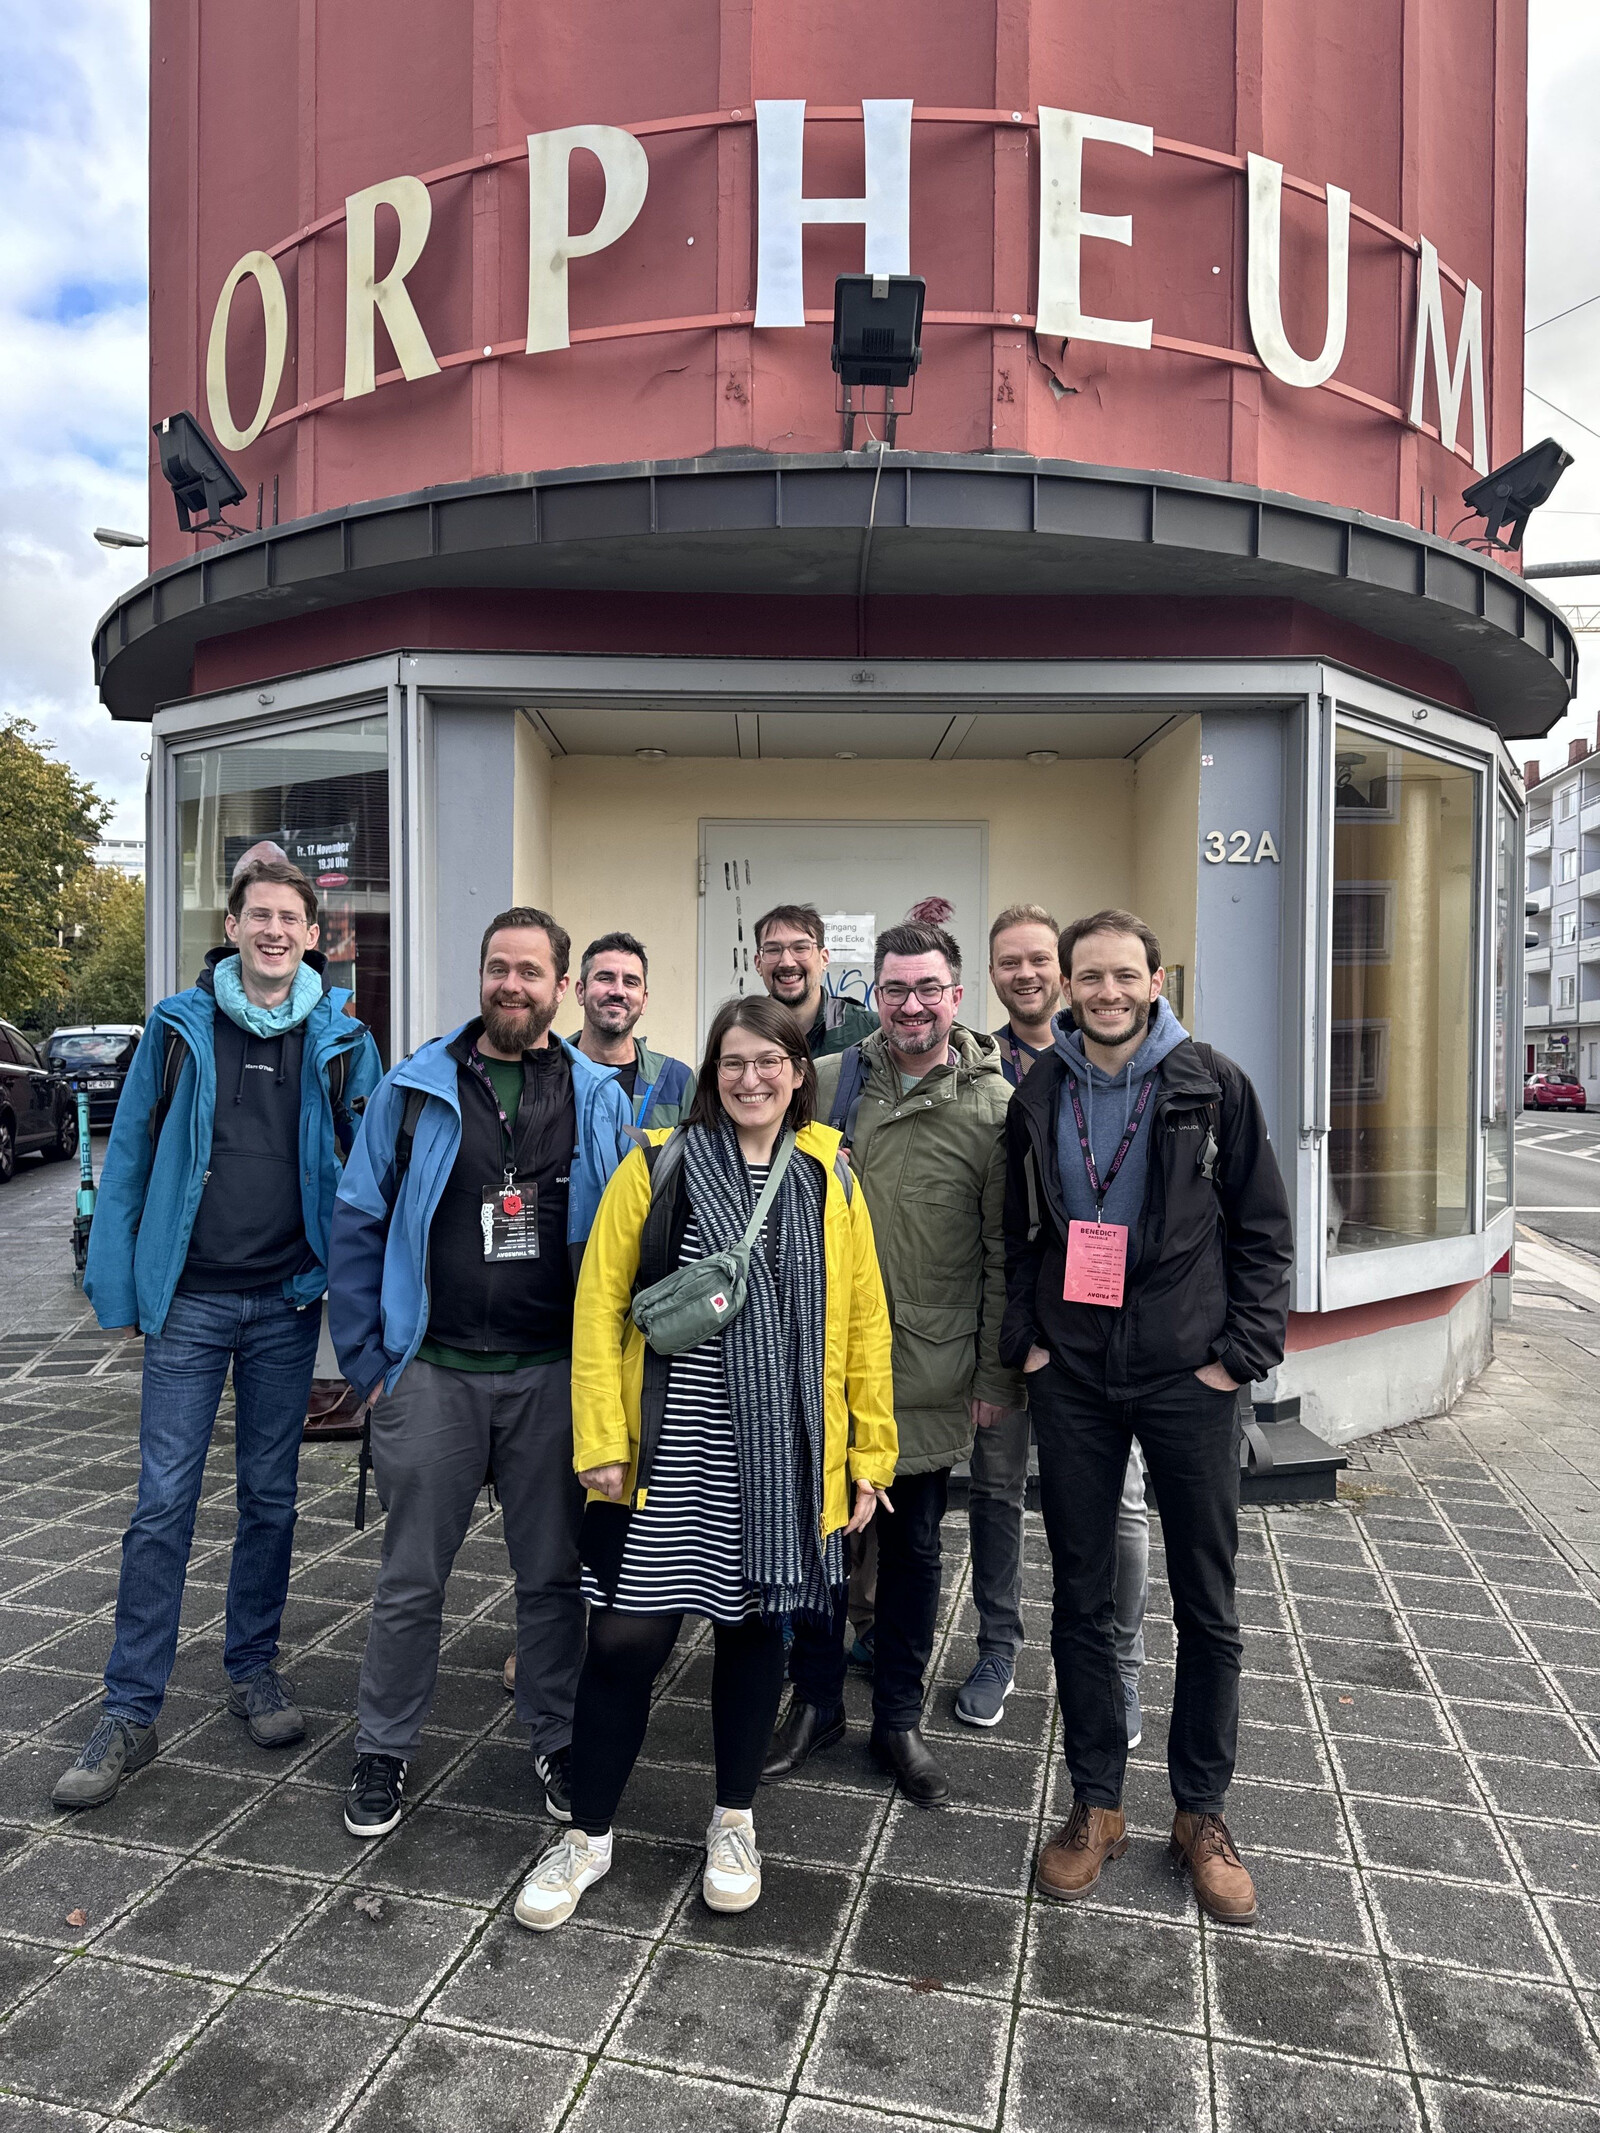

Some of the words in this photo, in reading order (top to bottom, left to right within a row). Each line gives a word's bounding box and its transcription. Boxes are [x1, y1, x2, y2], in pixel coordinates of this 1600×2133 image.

[206, 98, 1490, 477] ORPHEUM
[307, 844, 316, 856] 17.
[316, 842, 350, 855] November
[1205, 830, 1280, 864] 32A
[318, 858, 334, 870] 19.30
[335, 856, 348, 867] Uhr
[825, 923, 857, 932] Eingang
[1080, 1227, 1118, 1238] BENEDICT
